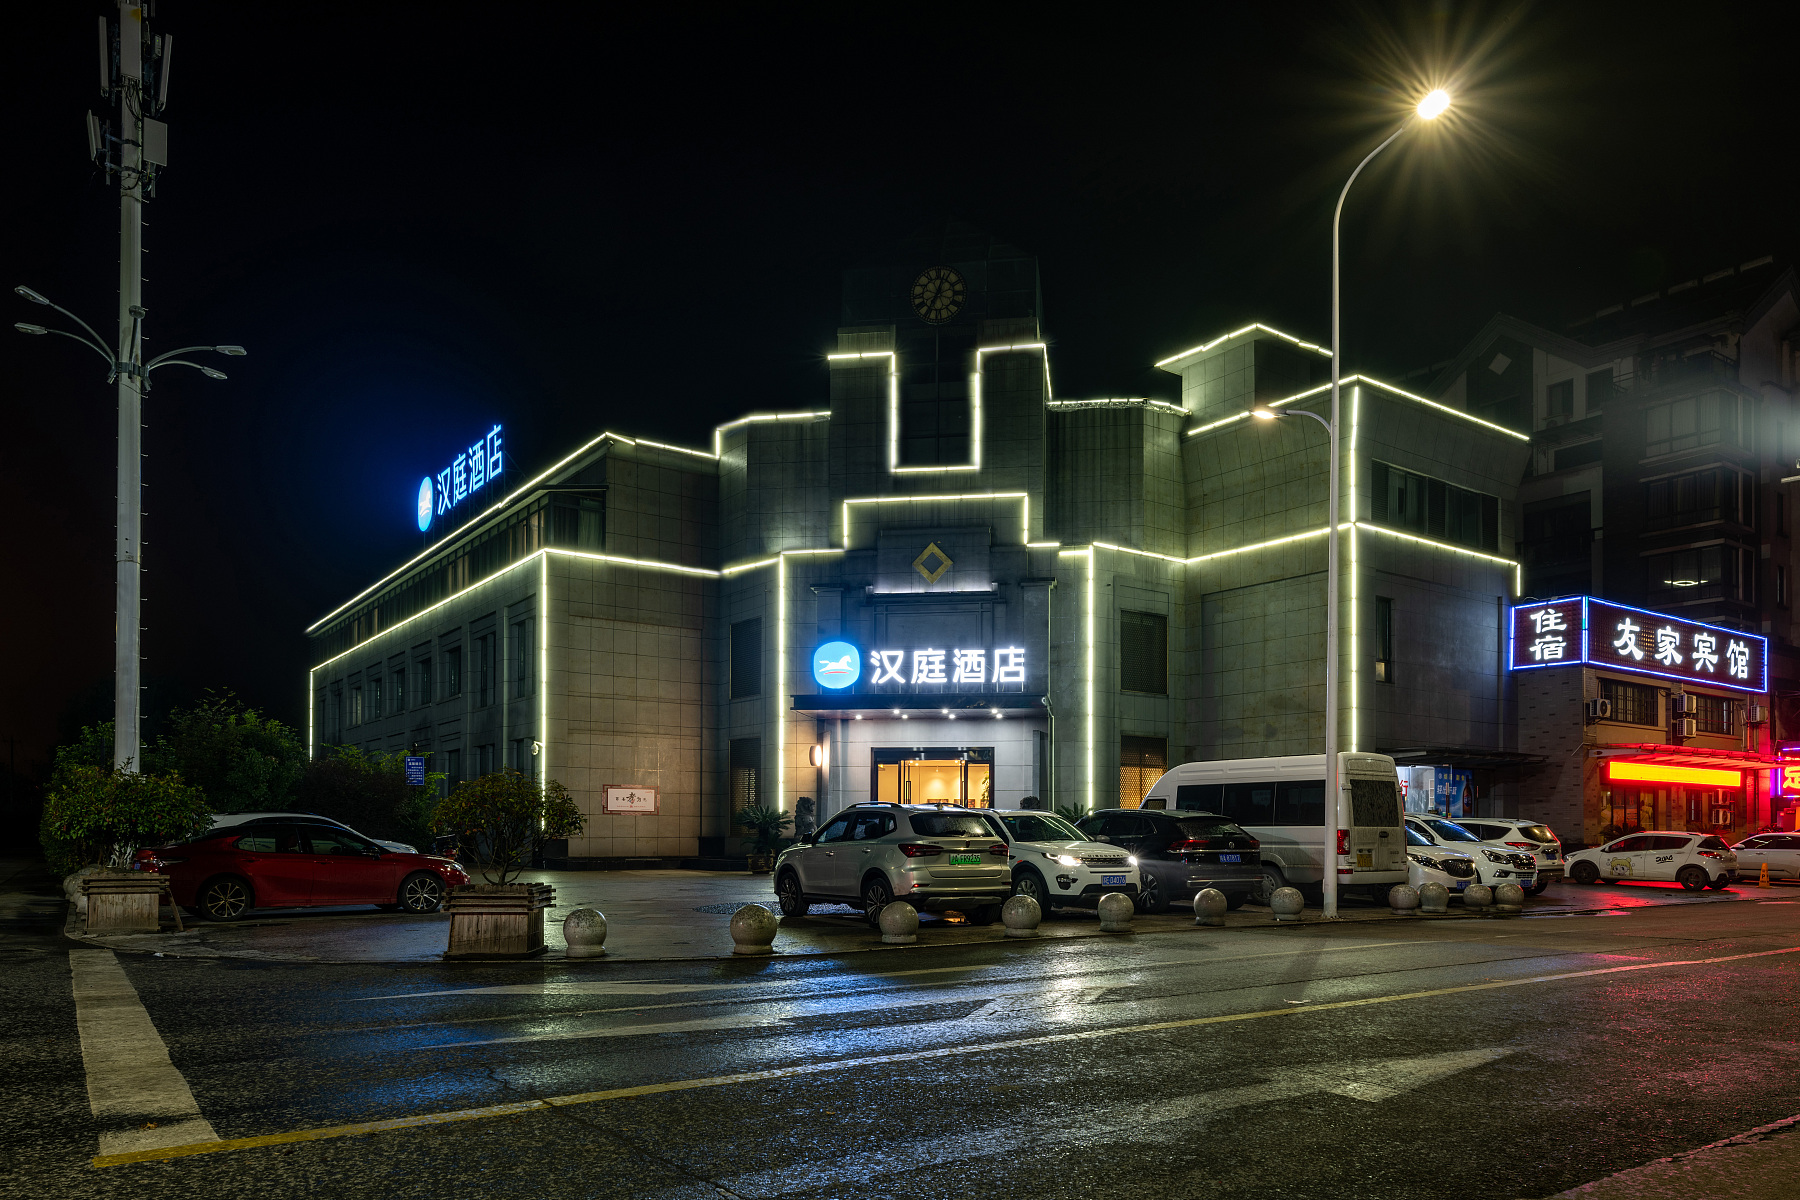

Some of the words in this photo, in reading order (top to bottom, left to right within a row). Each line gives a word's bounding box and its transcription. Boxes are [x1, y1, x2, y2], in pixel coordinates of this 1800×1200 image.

[437, 424, 502, 516] 汉庭酒店
[1529, 608, 1567, 660] 住宿
[1613, 617, 1750, 680] 友家宾馆
[869, 646, 1025, 684] 汉庭酒店
